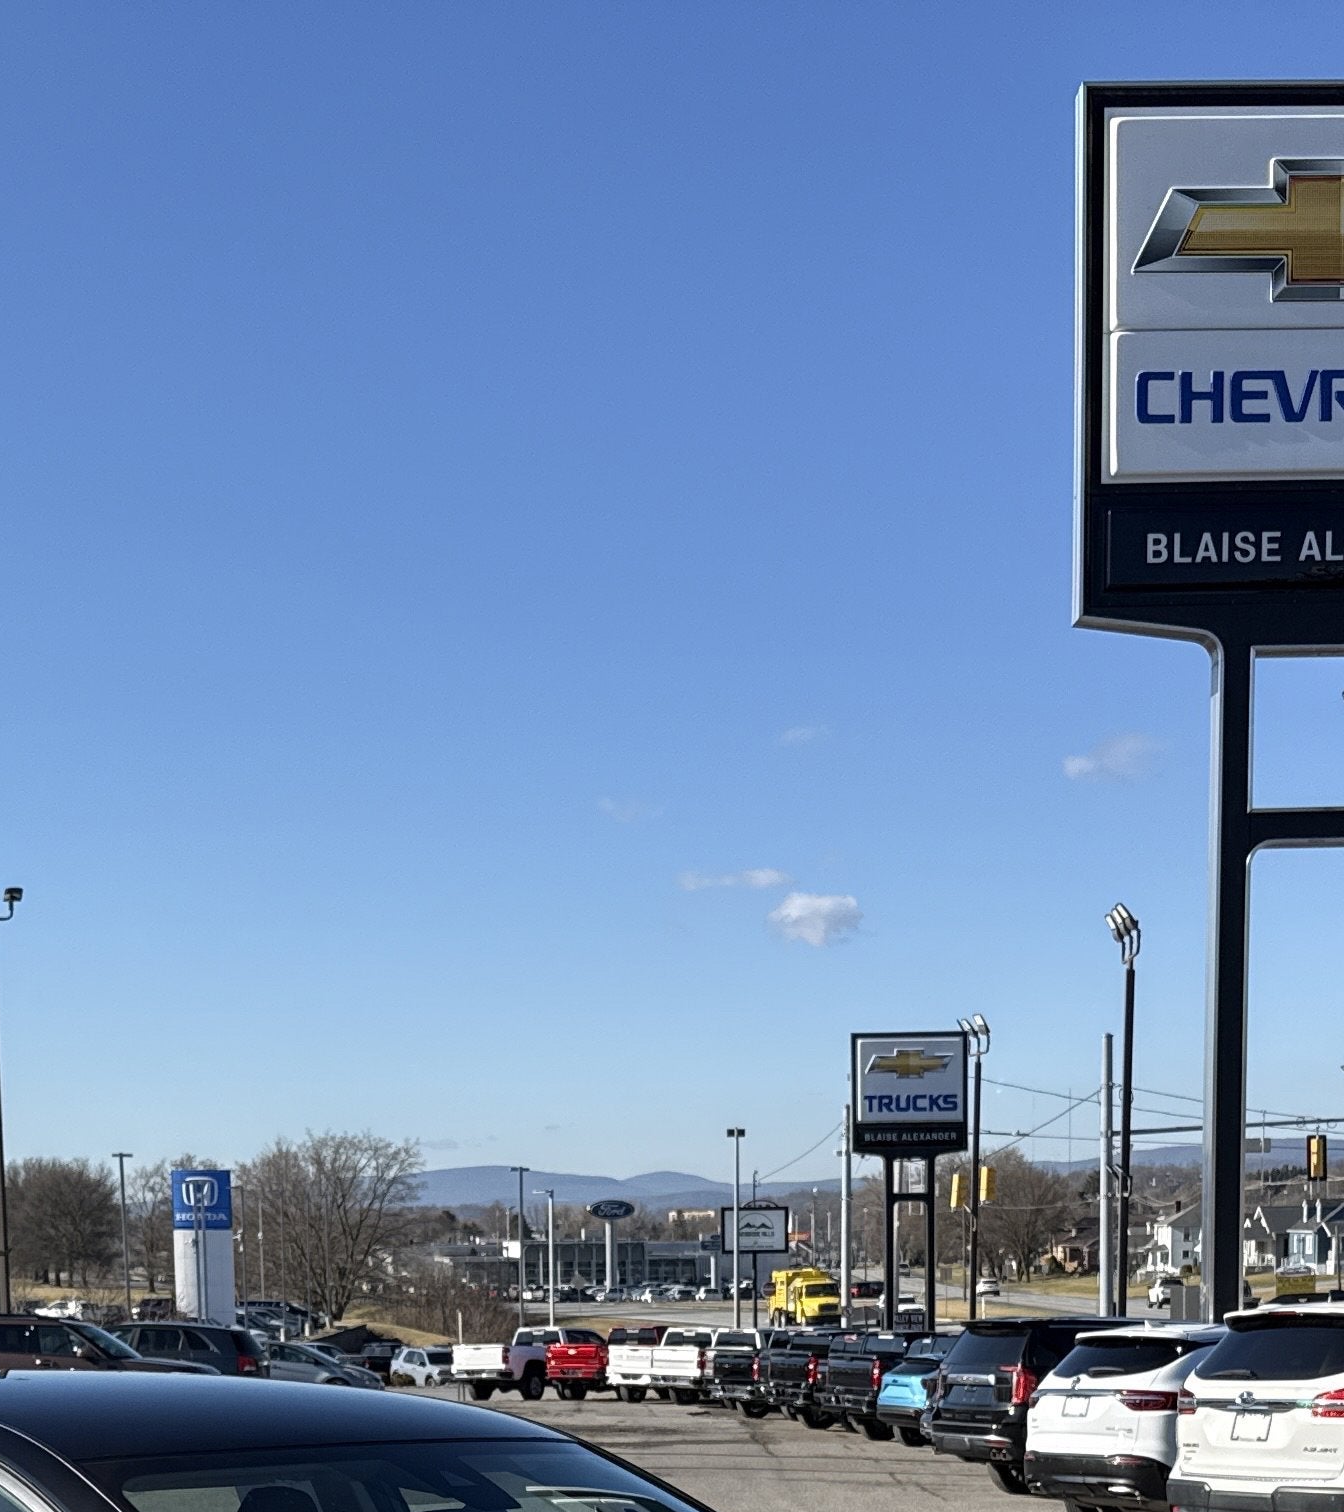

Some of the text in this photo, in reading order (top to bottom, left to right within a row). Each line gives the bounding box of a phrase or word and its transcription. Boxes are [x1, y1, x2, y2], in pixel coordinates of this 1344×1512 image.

[1146, 531, 1282, 564] BLAISE
[863, 1093, 959, 1113] TRUCKS
[864, 1131, 957, 1142] BLAISE ALEXANDER
[598, 1202, 626, 1216] Ford
